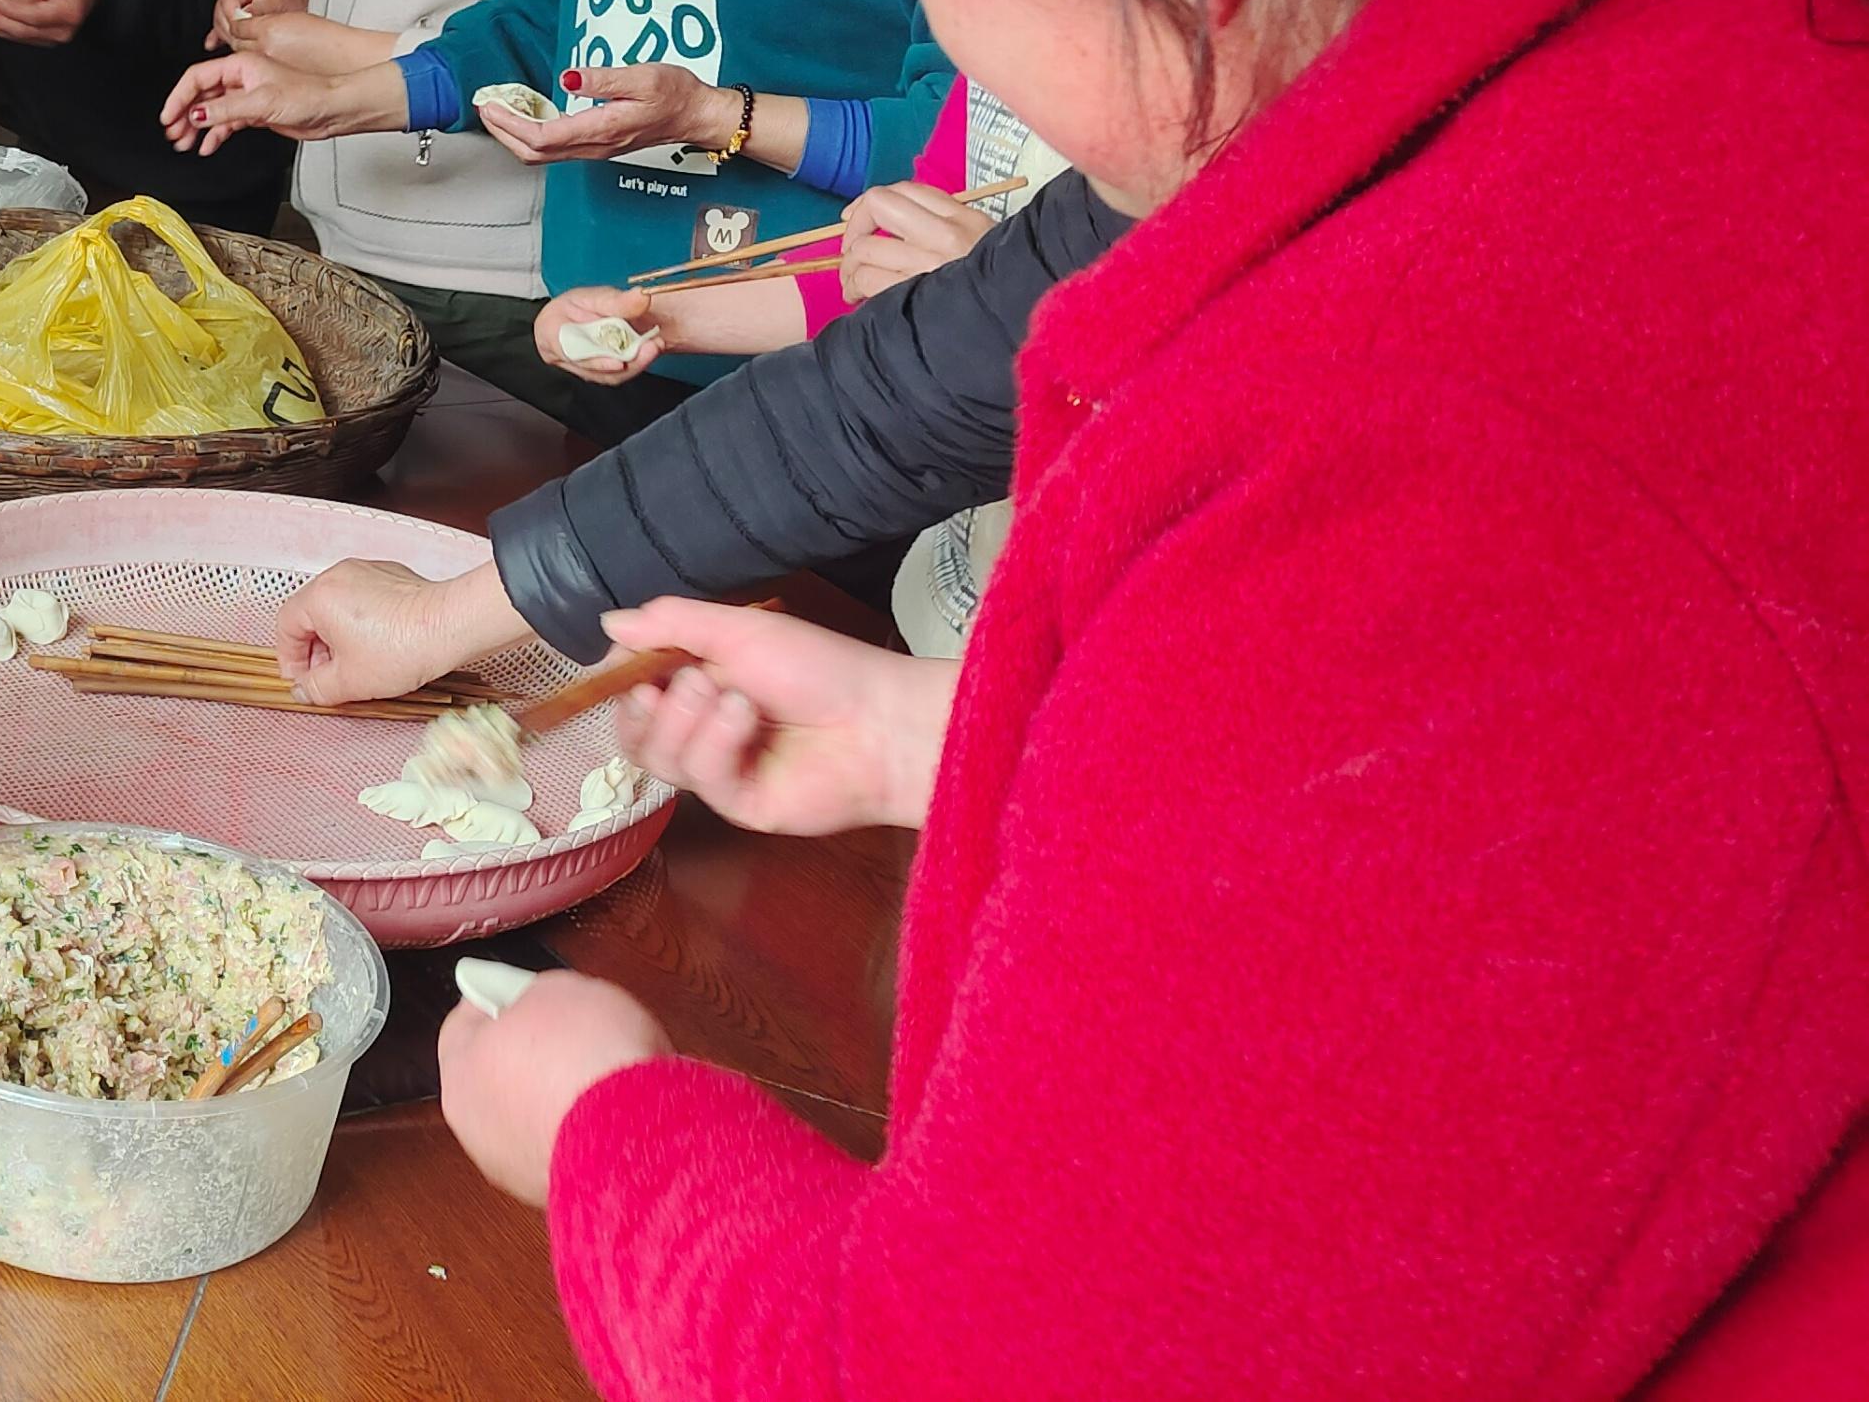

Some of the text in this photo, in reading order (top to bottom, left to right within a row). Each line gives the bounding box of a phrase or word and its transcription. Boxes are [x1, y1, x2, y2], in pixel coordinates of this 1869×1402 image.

[621, 4, 716, 65] DO
[618, 174, 688, 197] Let's play out
